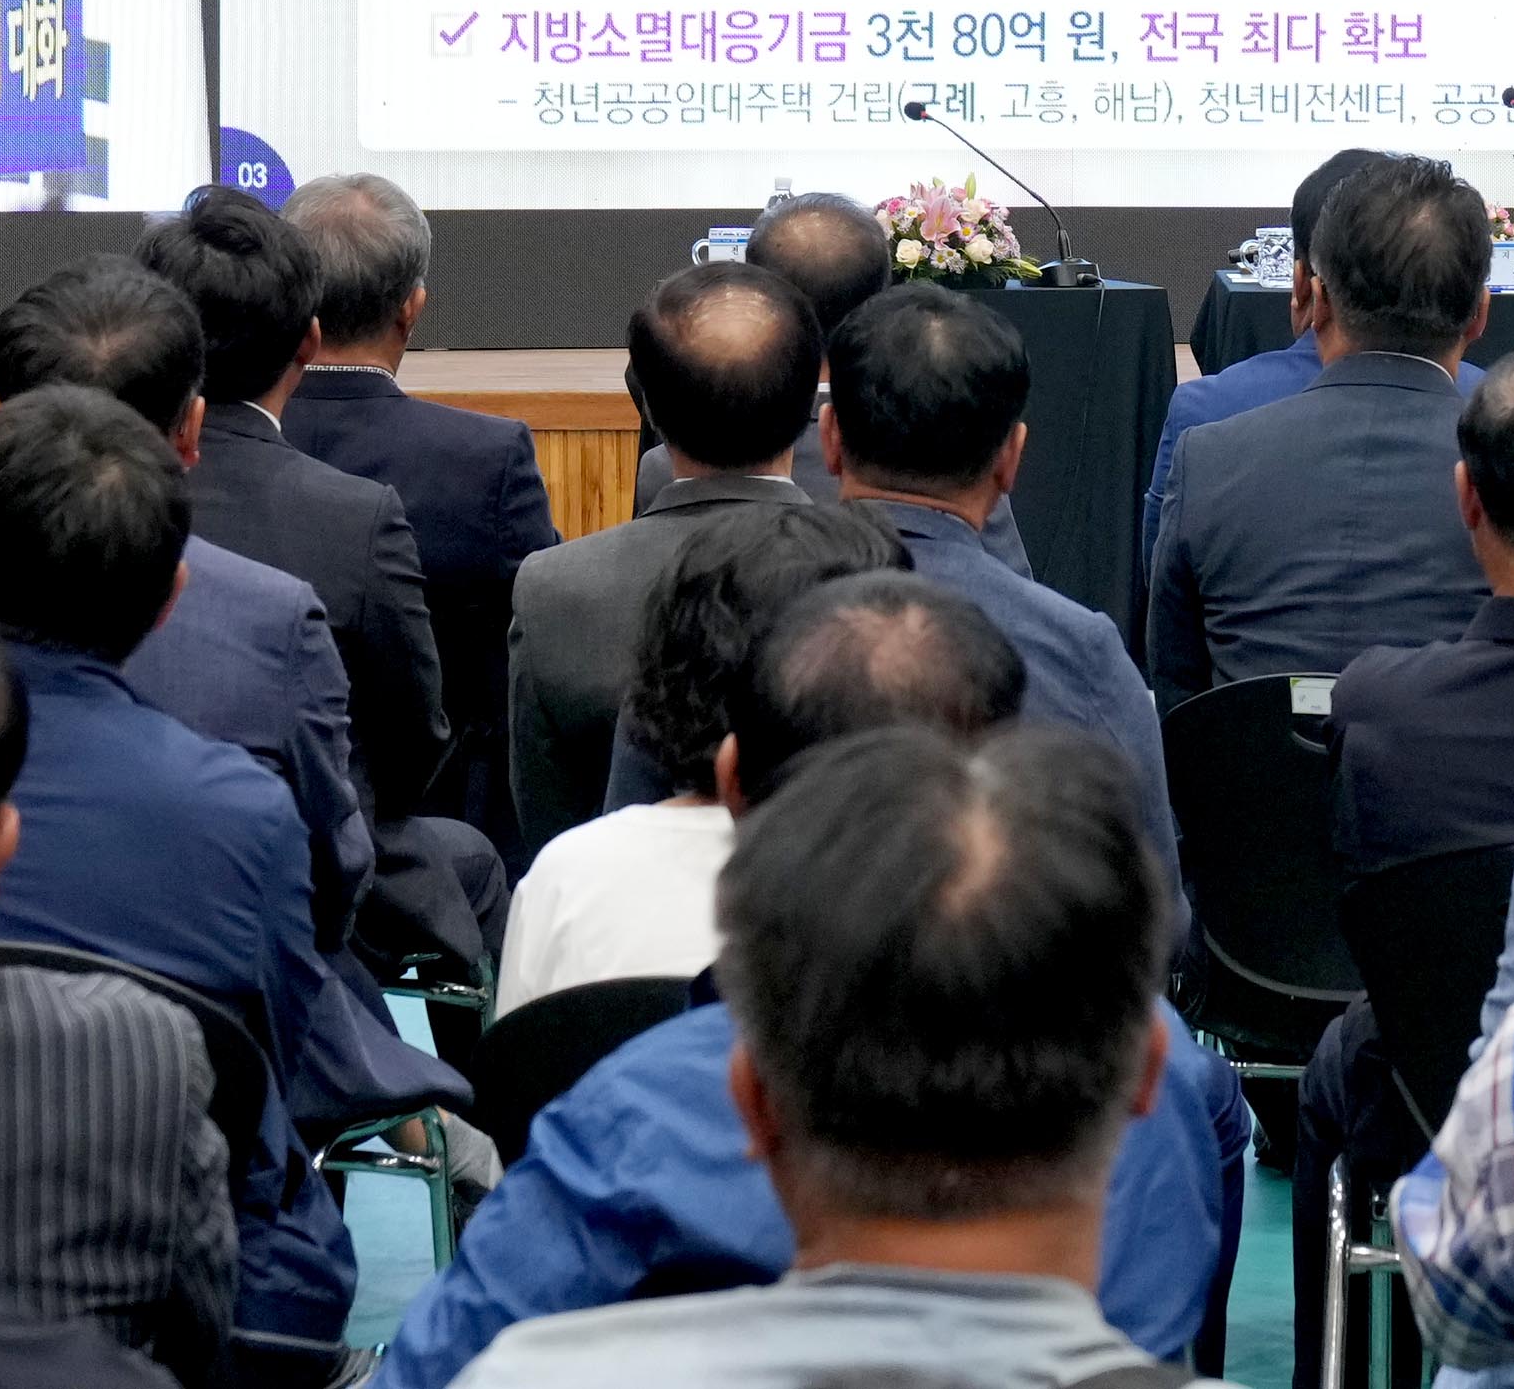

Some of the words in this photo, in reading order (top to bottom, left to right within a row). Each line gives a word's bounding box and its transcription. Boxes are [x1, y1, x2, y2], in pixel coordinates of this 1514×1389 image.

[501, 10, 851, 64] 지방소멸대응기금
[866, 10, 934, 62] 3천
[952, 11, 1046, 62] 80억
[1067, 10, 1118, 63] 원,
[1140, 12, 1223, 63] 전국
[1242, 12, 1326, 63] 최다
[1343, 12, 1427, 63] 확보
[533, 81, 812, 126] 청년공공임대주택
[1000, 81, 1078, 127] 고흥,
[1095, 81, 1184, 128] 해남),
[1199, 81, 1416, 128] 청년비전센터,
[237, 162, 267, 188] 03
